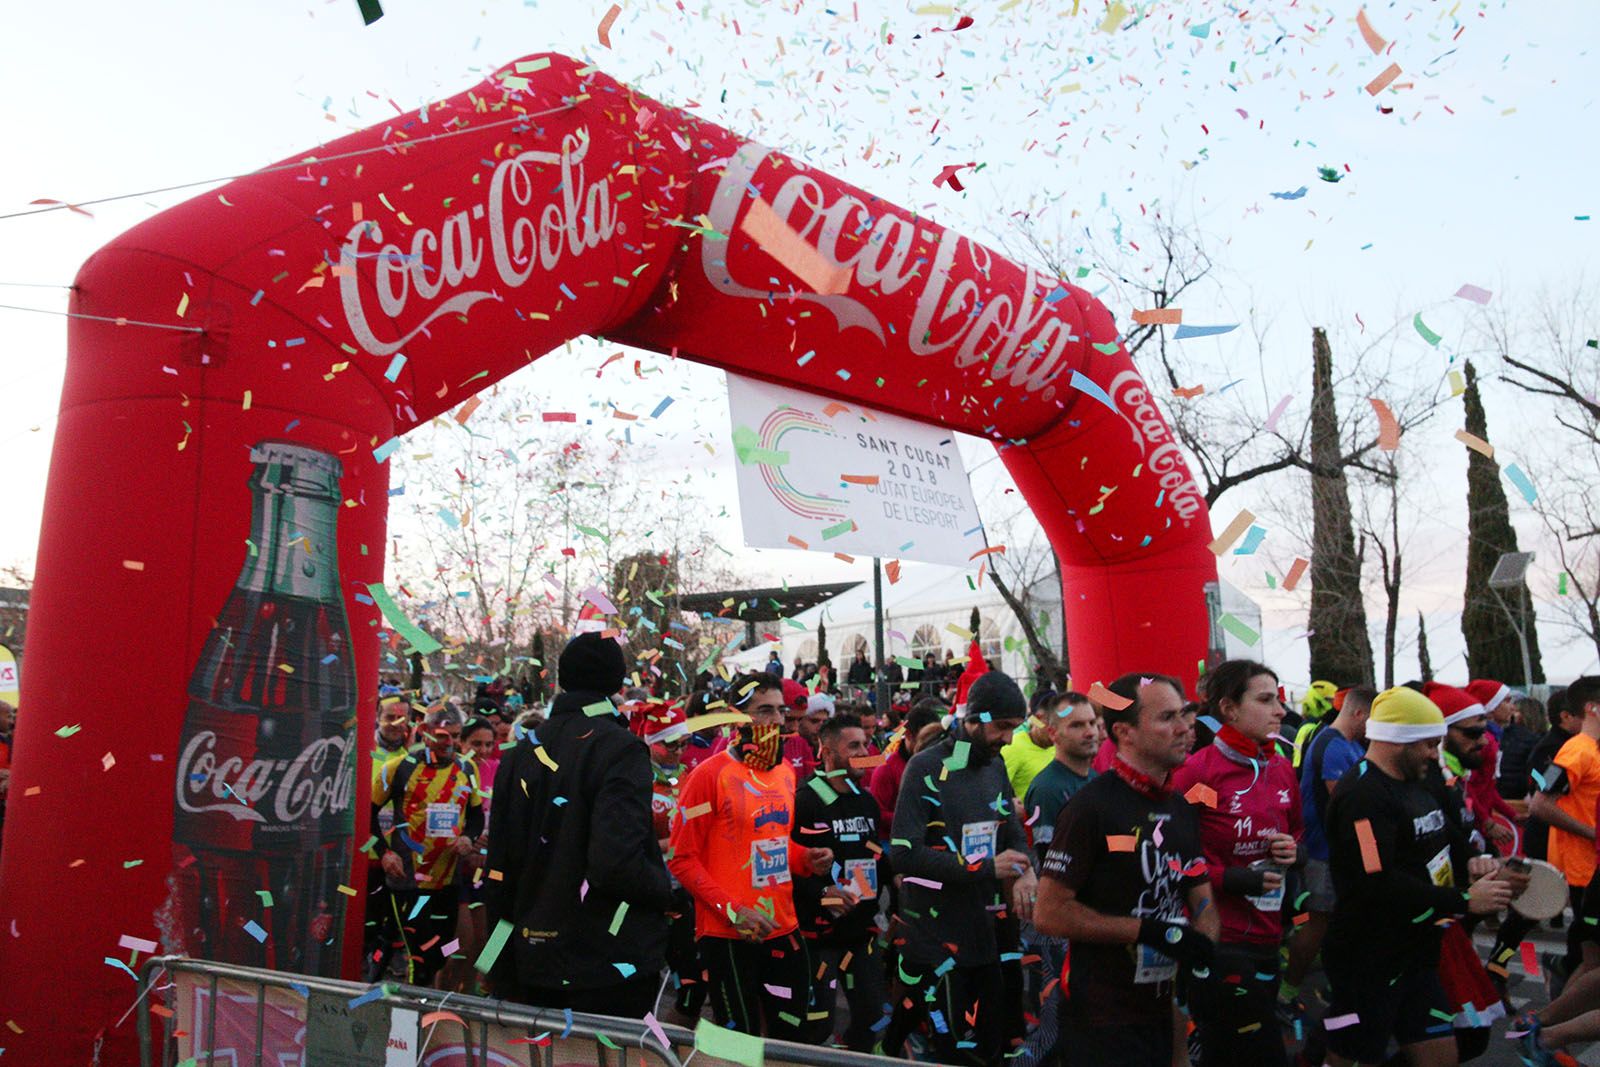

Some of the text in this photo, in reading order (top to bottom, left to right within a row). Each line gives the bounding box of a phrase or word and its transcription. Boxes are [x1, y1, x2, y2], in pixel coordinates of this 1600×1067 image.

[340, 125, 618, 356] Coca-Cola
[699, 142, 1073, 391] Coca-Cola
[856, 433, 952, 470] SANT CUGAT
[1109, 370, 1201, 520] Coca-Cola
[888, 460, 938, 486] 2018
[866, 479, 967, 512] CIUTAT EUROPEA
[883, 501, 960, 530] DE L'ESPORT
[176, 730, 354, 823] Coca-Cola
[760, 852, 786, 870] 1970
